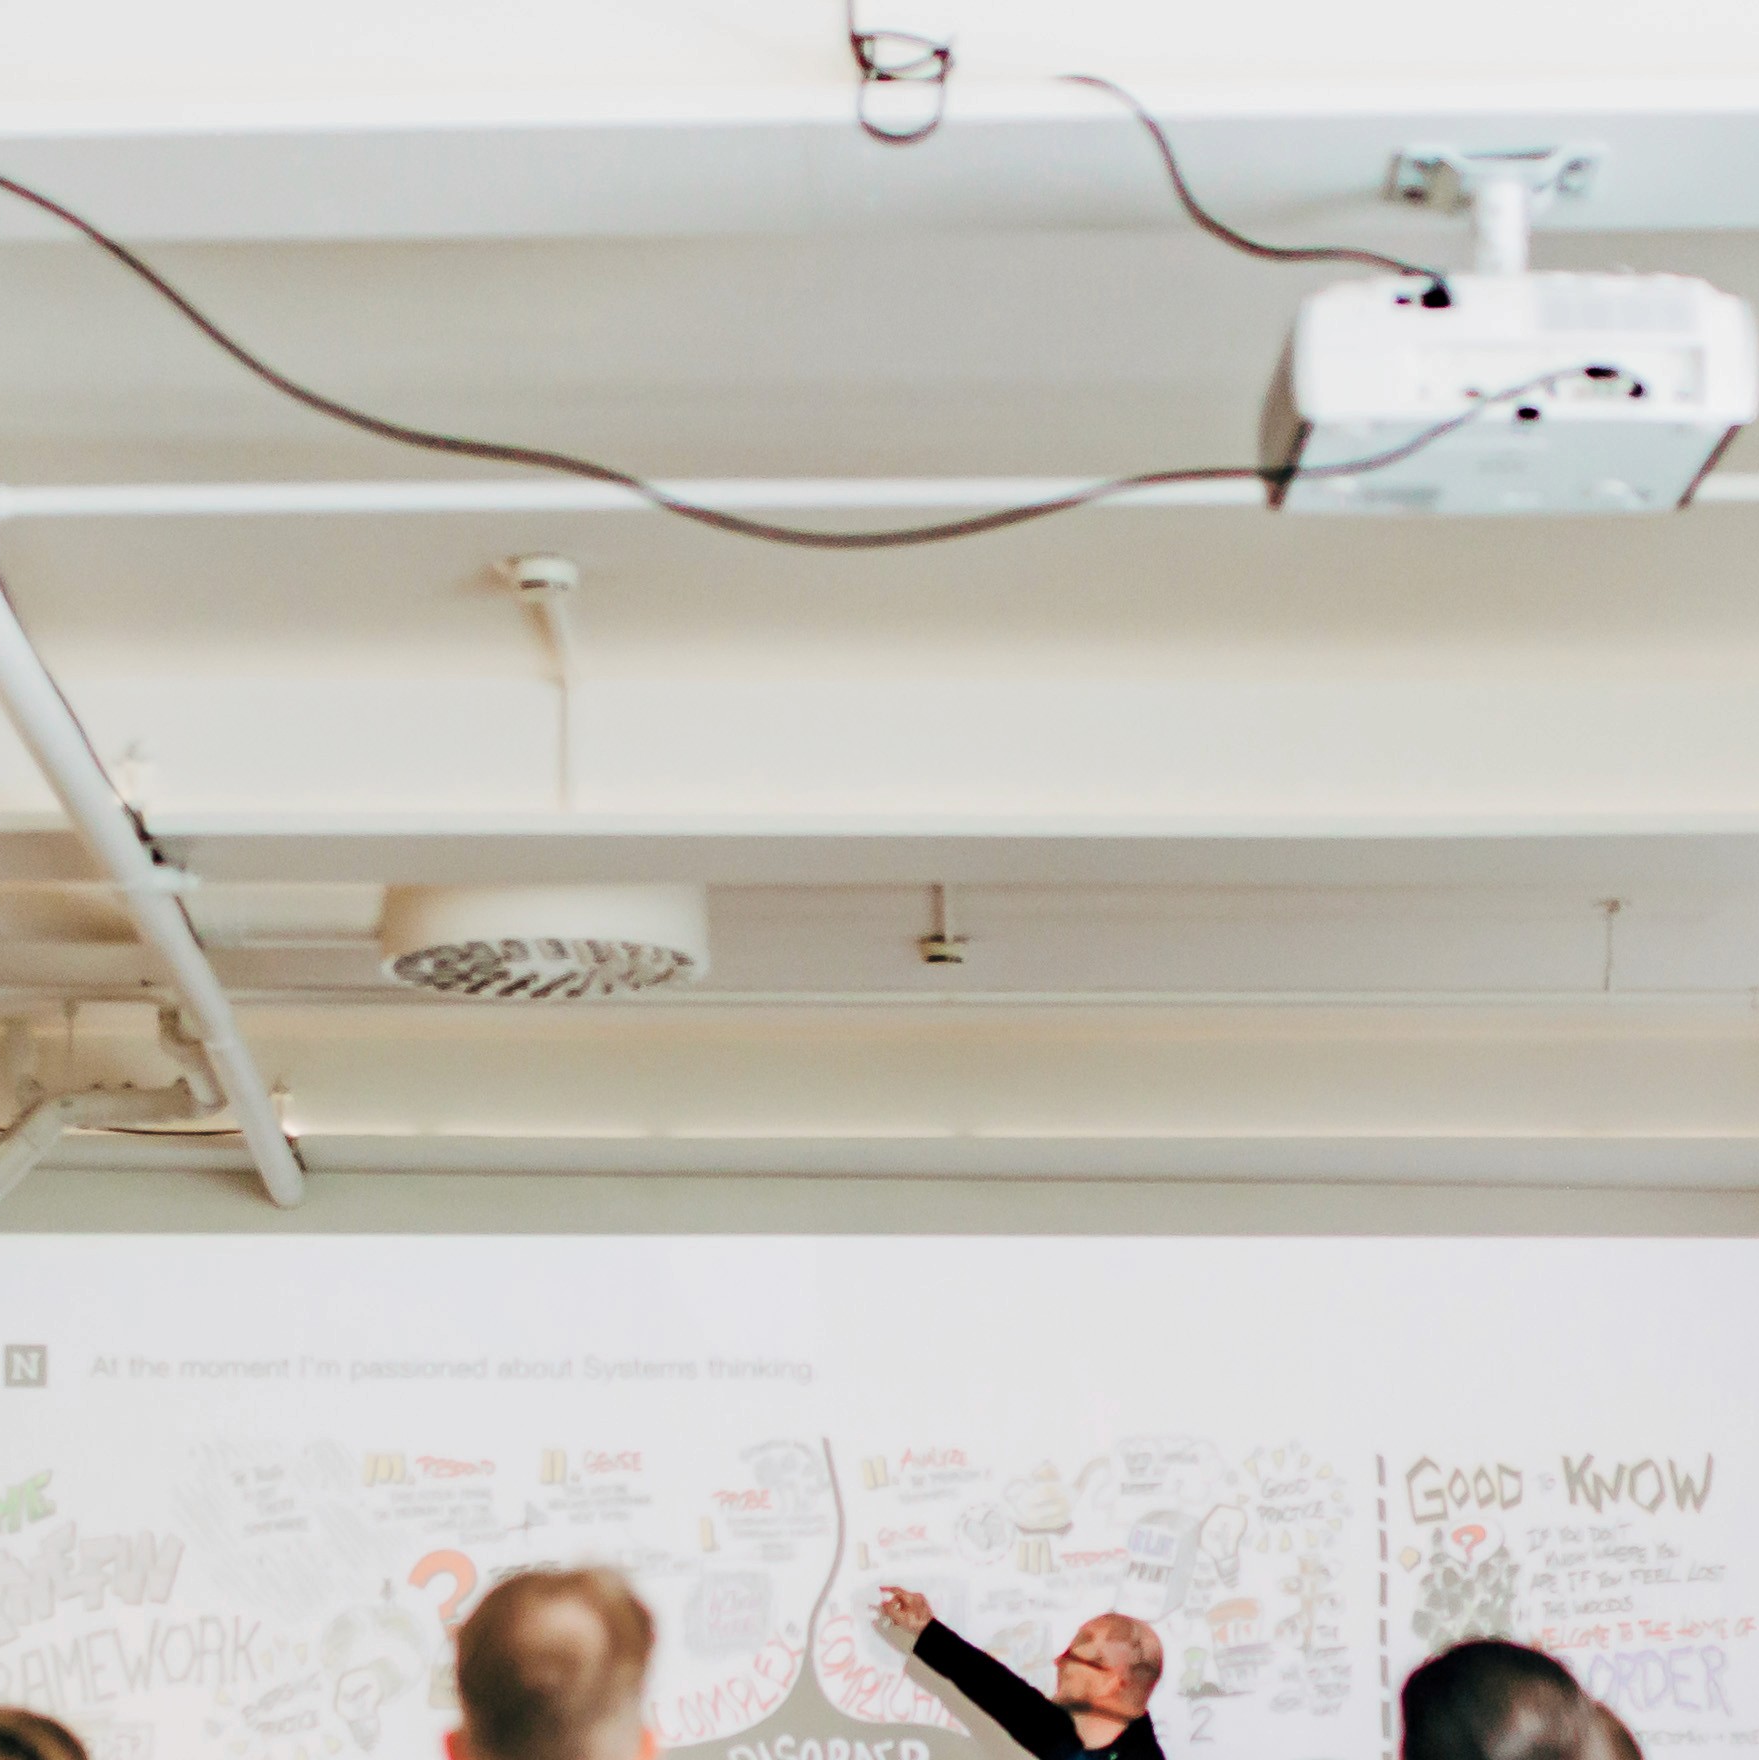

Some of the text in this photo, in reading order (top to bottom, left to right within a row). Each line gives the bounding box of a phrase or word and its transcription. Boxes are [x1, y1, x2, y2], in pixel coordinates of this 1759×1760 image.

[90, 1355, 119, 1377] At
[128, 1355, 170, 1377] the
[180, 1356, 290, 1378] moment
[300, 1356, 341, 1378] I'm
[349, 1355, 488, 1384] passioned
[497, 1355, 574, 1378] about
[583, 1355, 698, 1384] Systems
[1404, 1455, 1524, 1526] GOOD
[1561, 1451, 1715, 1515] KNOW
[1630, 1567, 1681, 1586] FEEL
[1529, 1623, 1610, 1650] ELCOME
[1562, 1644, 1734, 1718] ORDER
